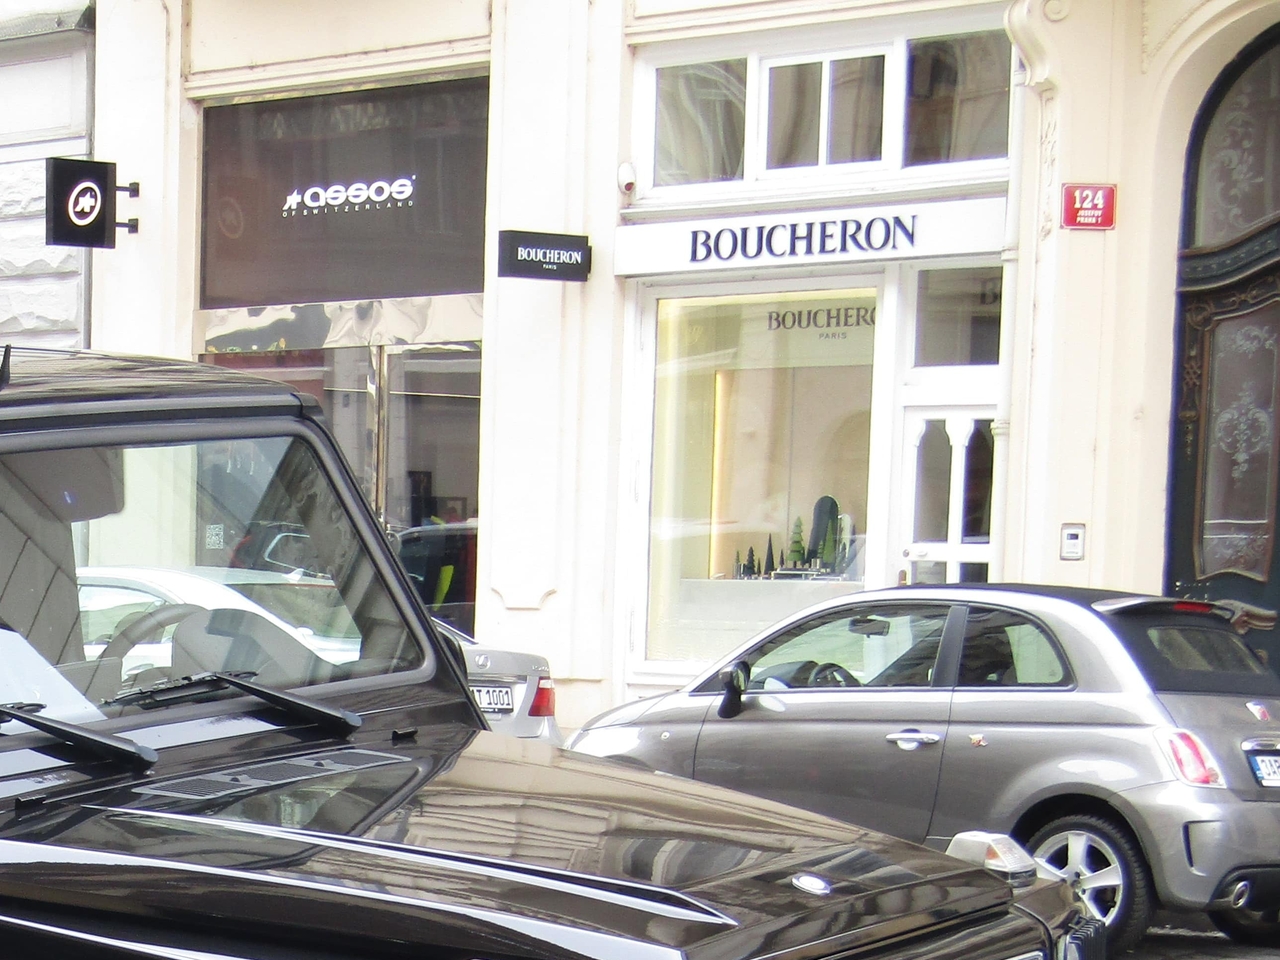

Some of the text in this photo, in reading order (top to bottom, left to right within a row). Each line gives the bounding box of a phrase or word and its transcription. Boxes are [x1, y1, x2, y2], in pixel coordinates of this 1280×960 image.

[303, 178, 414, 208] assos
[1073, 189, 1104, 209] 124
[282, 200, 413, 218] OF SWITZERLAND
[1075, 216, 1103, 224] PRAHA 1
[689, 214, 918, 263] BOUCHERON
[517, 246, 582, 264] BOUCHERON
[818, 331, 848, 340] PARIS
[485, 689, 511, 707] 1001
